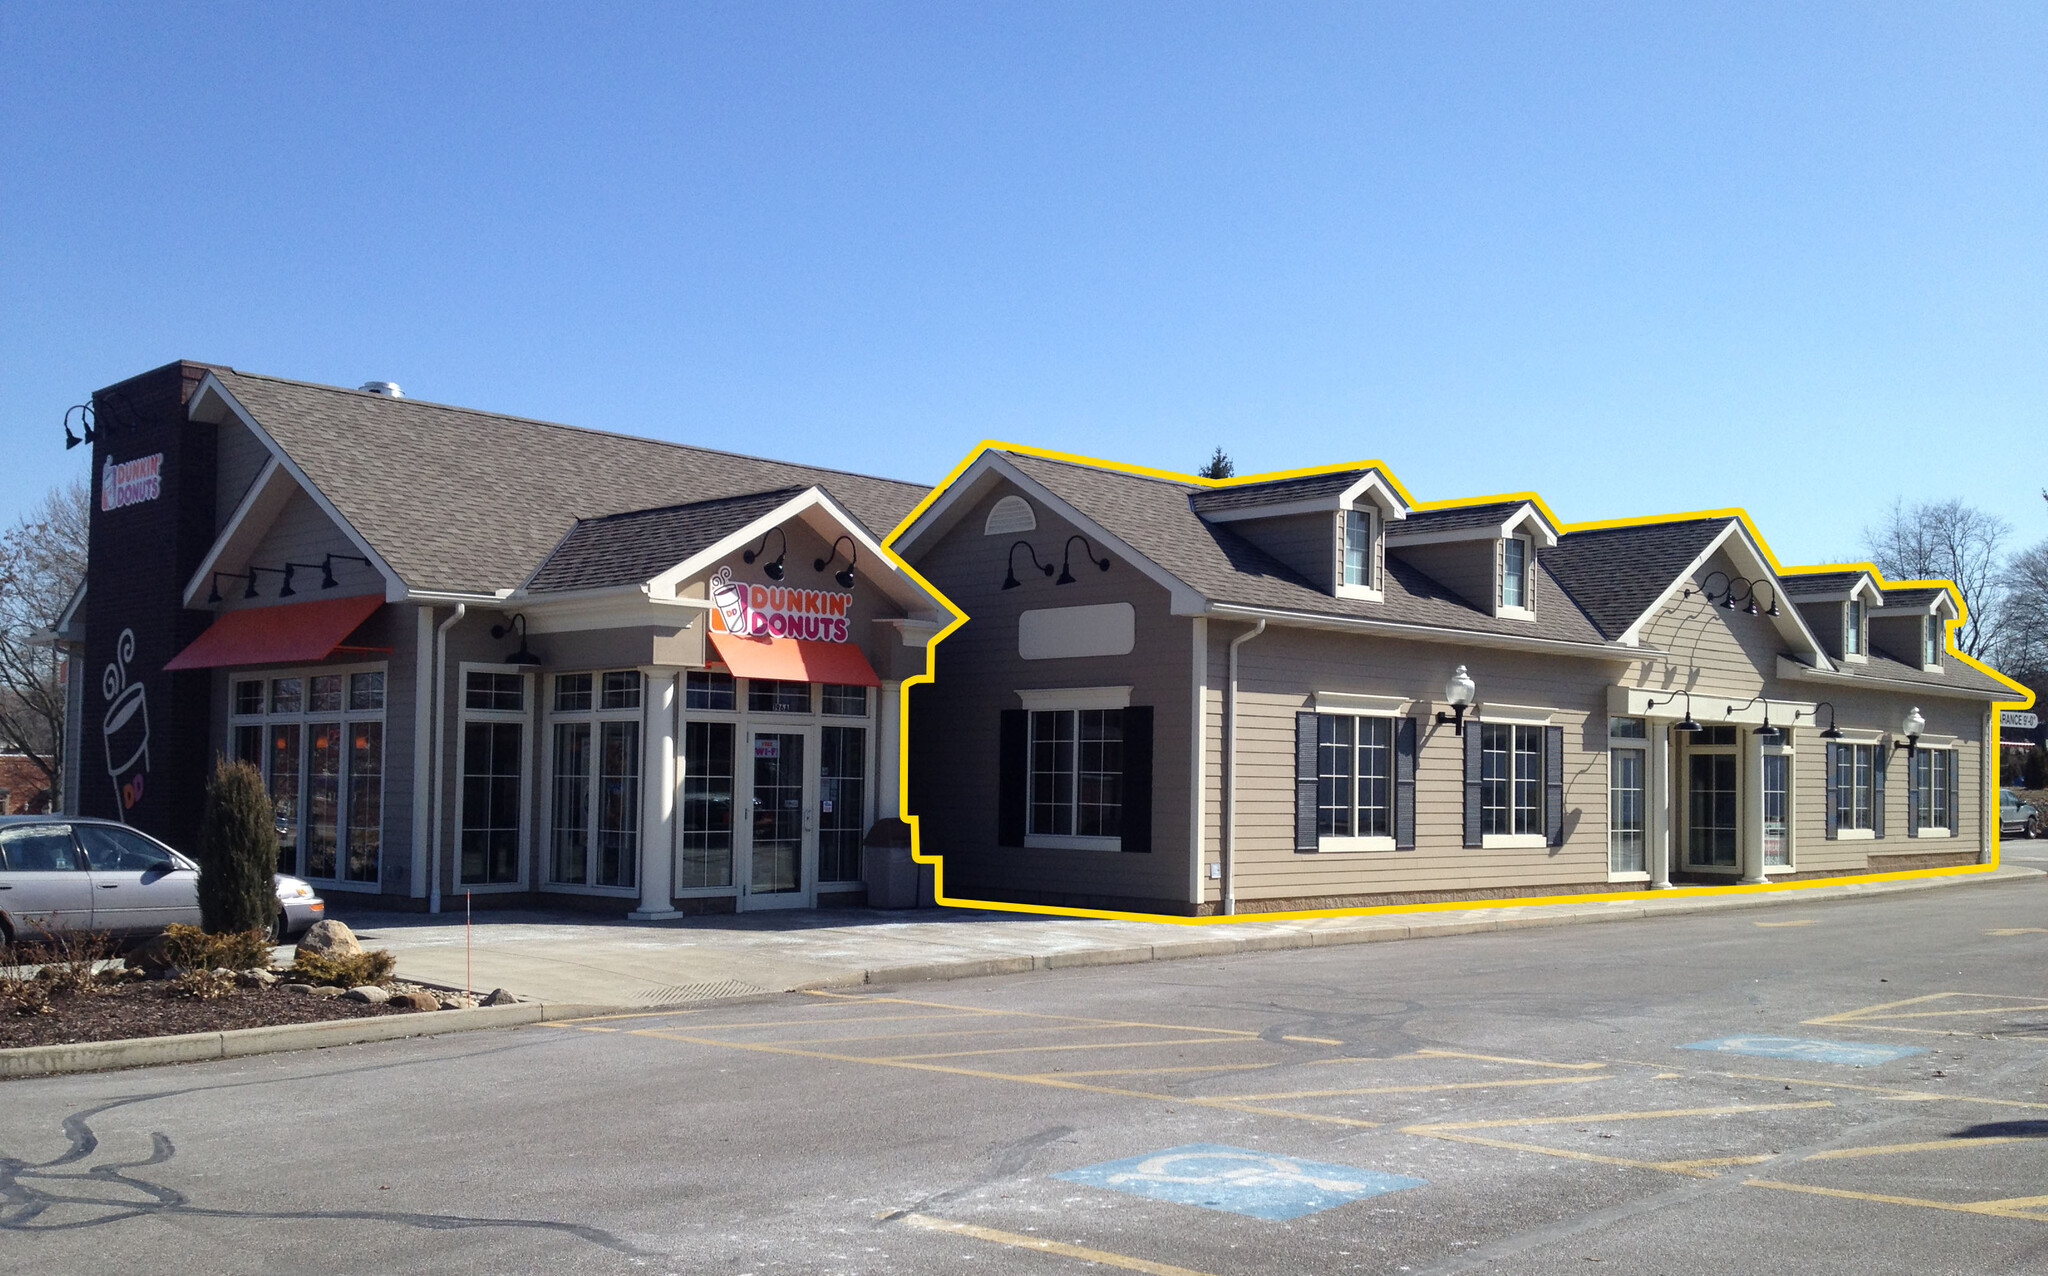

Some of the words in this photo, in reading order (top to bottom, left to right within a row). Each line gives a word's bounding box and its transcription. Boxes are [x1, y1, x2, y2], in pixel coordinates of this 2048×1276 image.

[117, 454, 162, 485] DUNKIN'
[117, 477, 158, 506] DONUTS
[726, 608, 738, 617] DD
[751, 586, 852, 616] DUNKIN'
[751, 612, 847, 641] DONUTS
[2000, 713, 2022, 726] RANCE
